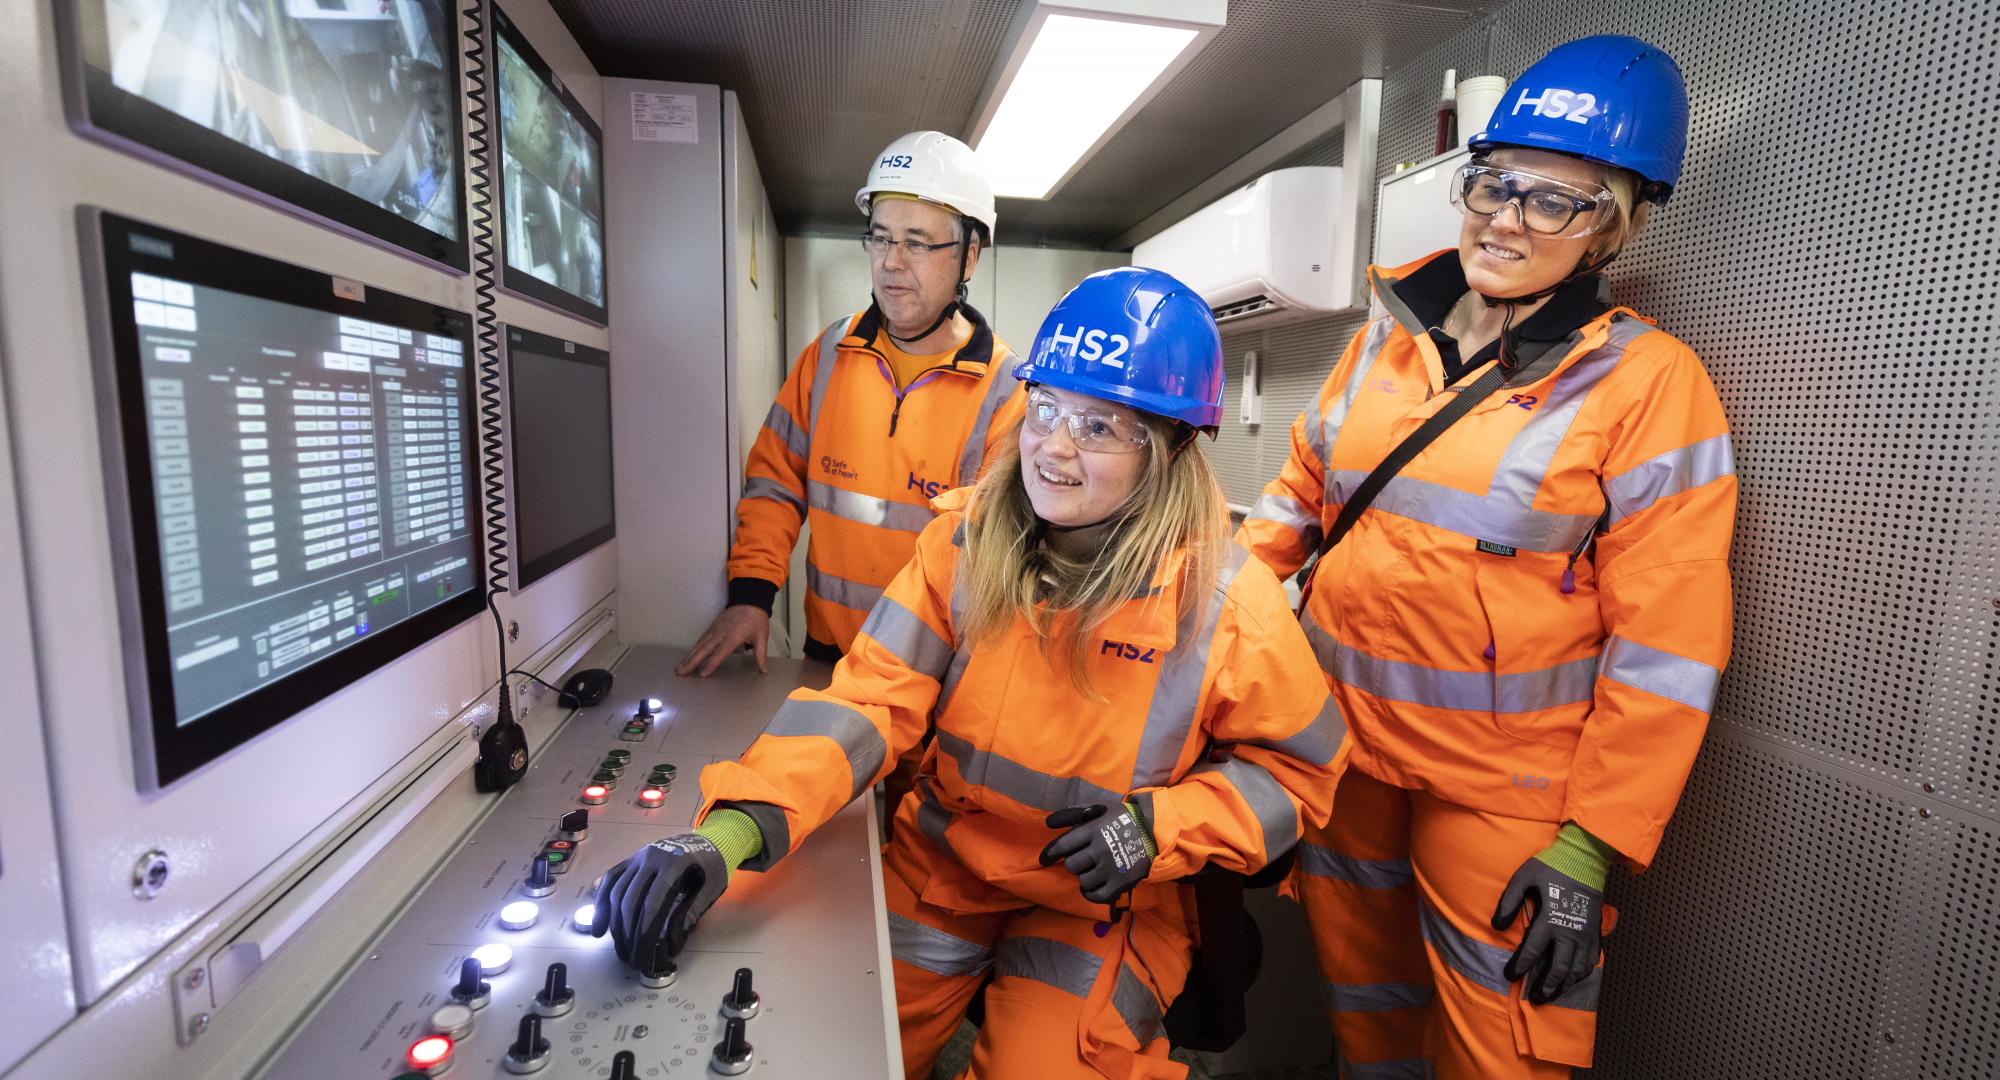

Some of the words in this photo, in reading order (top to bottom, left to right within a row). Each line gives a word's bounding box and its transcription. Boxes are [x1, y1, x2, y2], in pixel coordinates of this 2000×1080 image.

[1511, 87, 1597, 125] HS2
[880, 155, 913, 169] HS2
[1049, 322, 1129, 369] HS2
[1506, 394, 1538, 411] S2
[907, 471, 949, 500] HS
